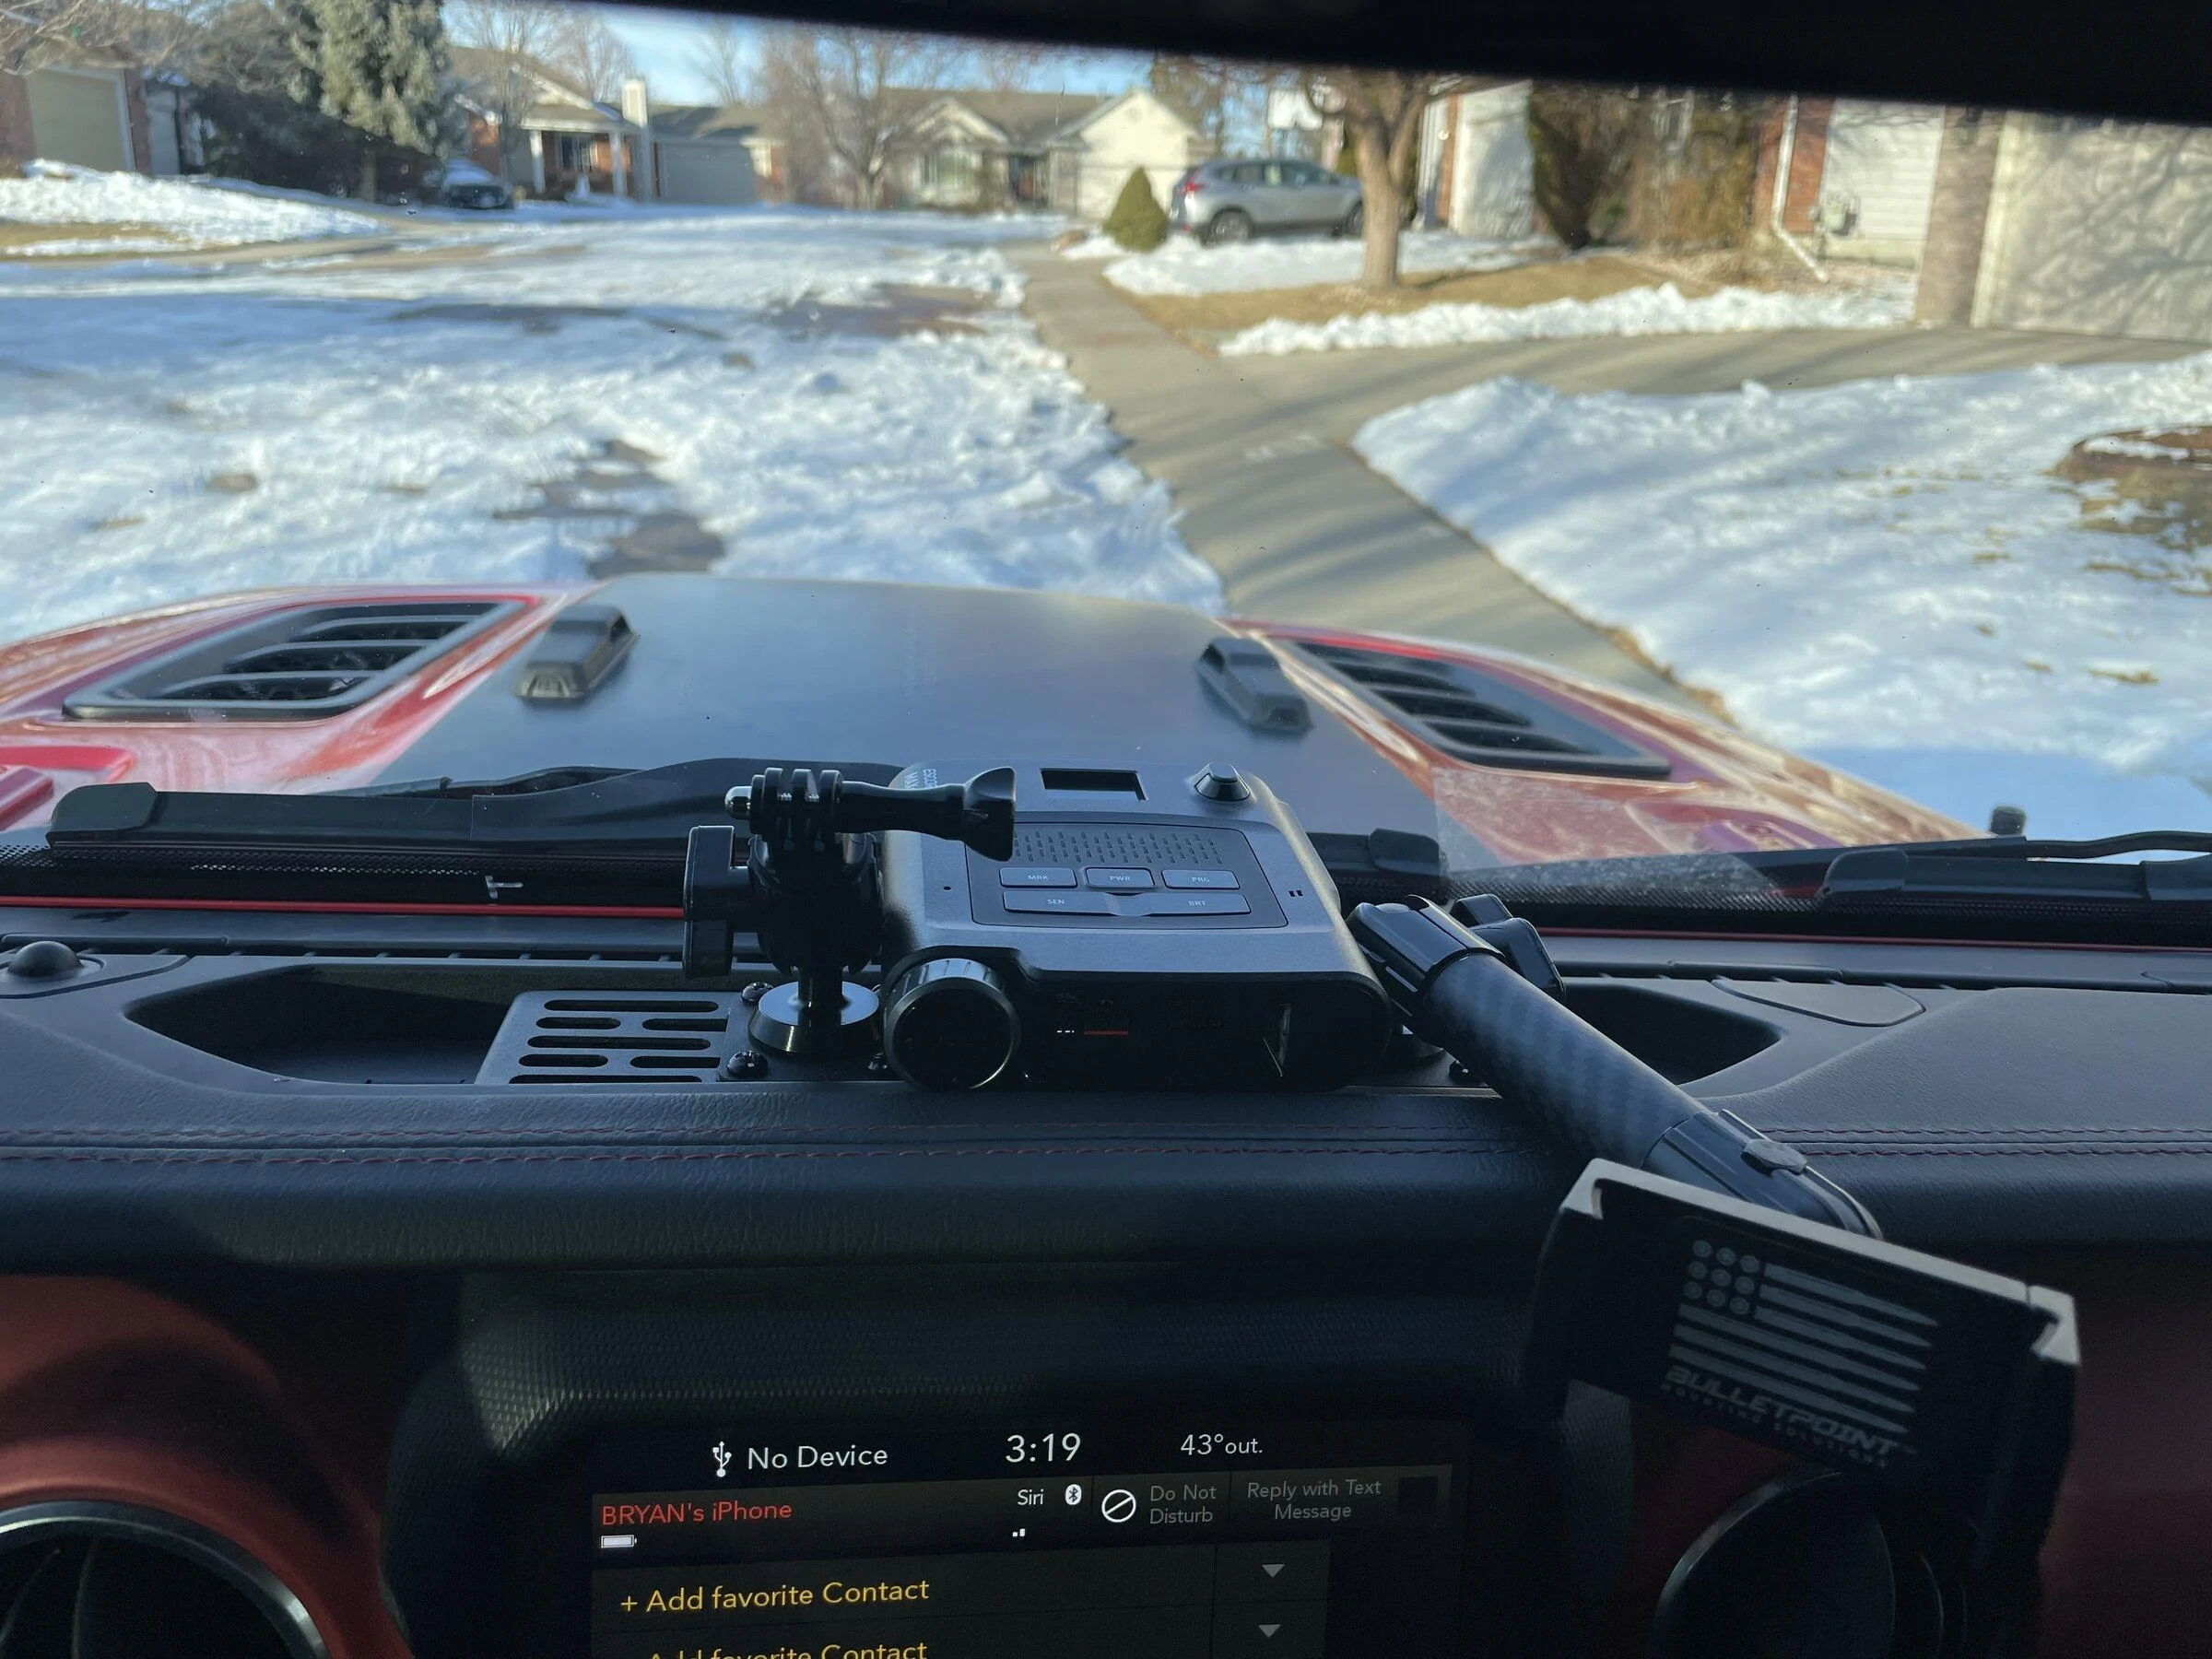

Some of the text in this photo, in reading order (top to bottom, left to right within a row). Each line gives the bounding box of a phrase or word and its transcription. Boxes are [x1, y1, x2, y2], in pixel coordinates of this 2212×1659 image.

[1664, 1364, 1900, 1453] BULLETPOINT
[747, 1444, 888, 1469] No Device
[1006, 1433, 1081, 1463] 3:19
[1017, 1488, 1044, 1506] Siri
[1150, 1484, 1217, 1501] Do Not
[1247, 1478, 1382, 1503] Reply with Text
[602, 1500, 793, 1525] BRYAN's iPhone
[1149, 1508, 1214, 1524] Disturb
[1275, 1503, 1352, 1522] Message
[646, 1586, 703, 1612] Add
[712, 1583, 814, 1609] favorite
[822, 1580, 930, 1604] Contact
